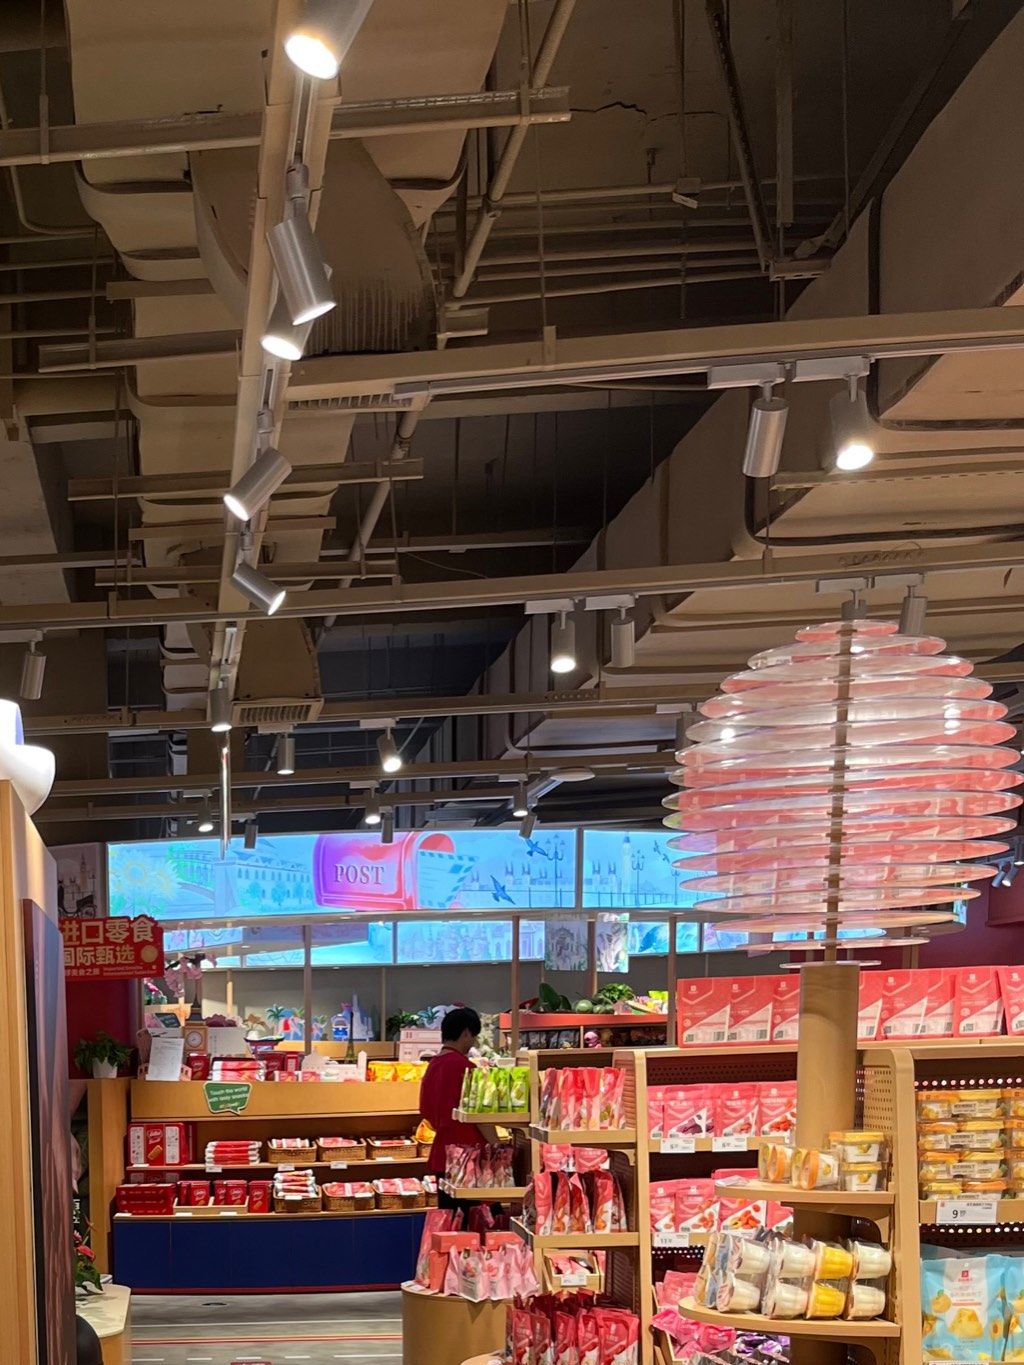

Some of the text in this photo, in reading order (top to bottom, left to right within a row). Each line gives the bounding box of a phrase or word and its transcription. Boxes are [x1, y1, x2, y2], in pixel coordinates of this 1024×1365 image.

[334, 864, 385, 885] POST
[63, 917, 155, 945] 进口零食
[64, 945, 135, 967] 国际甄选
